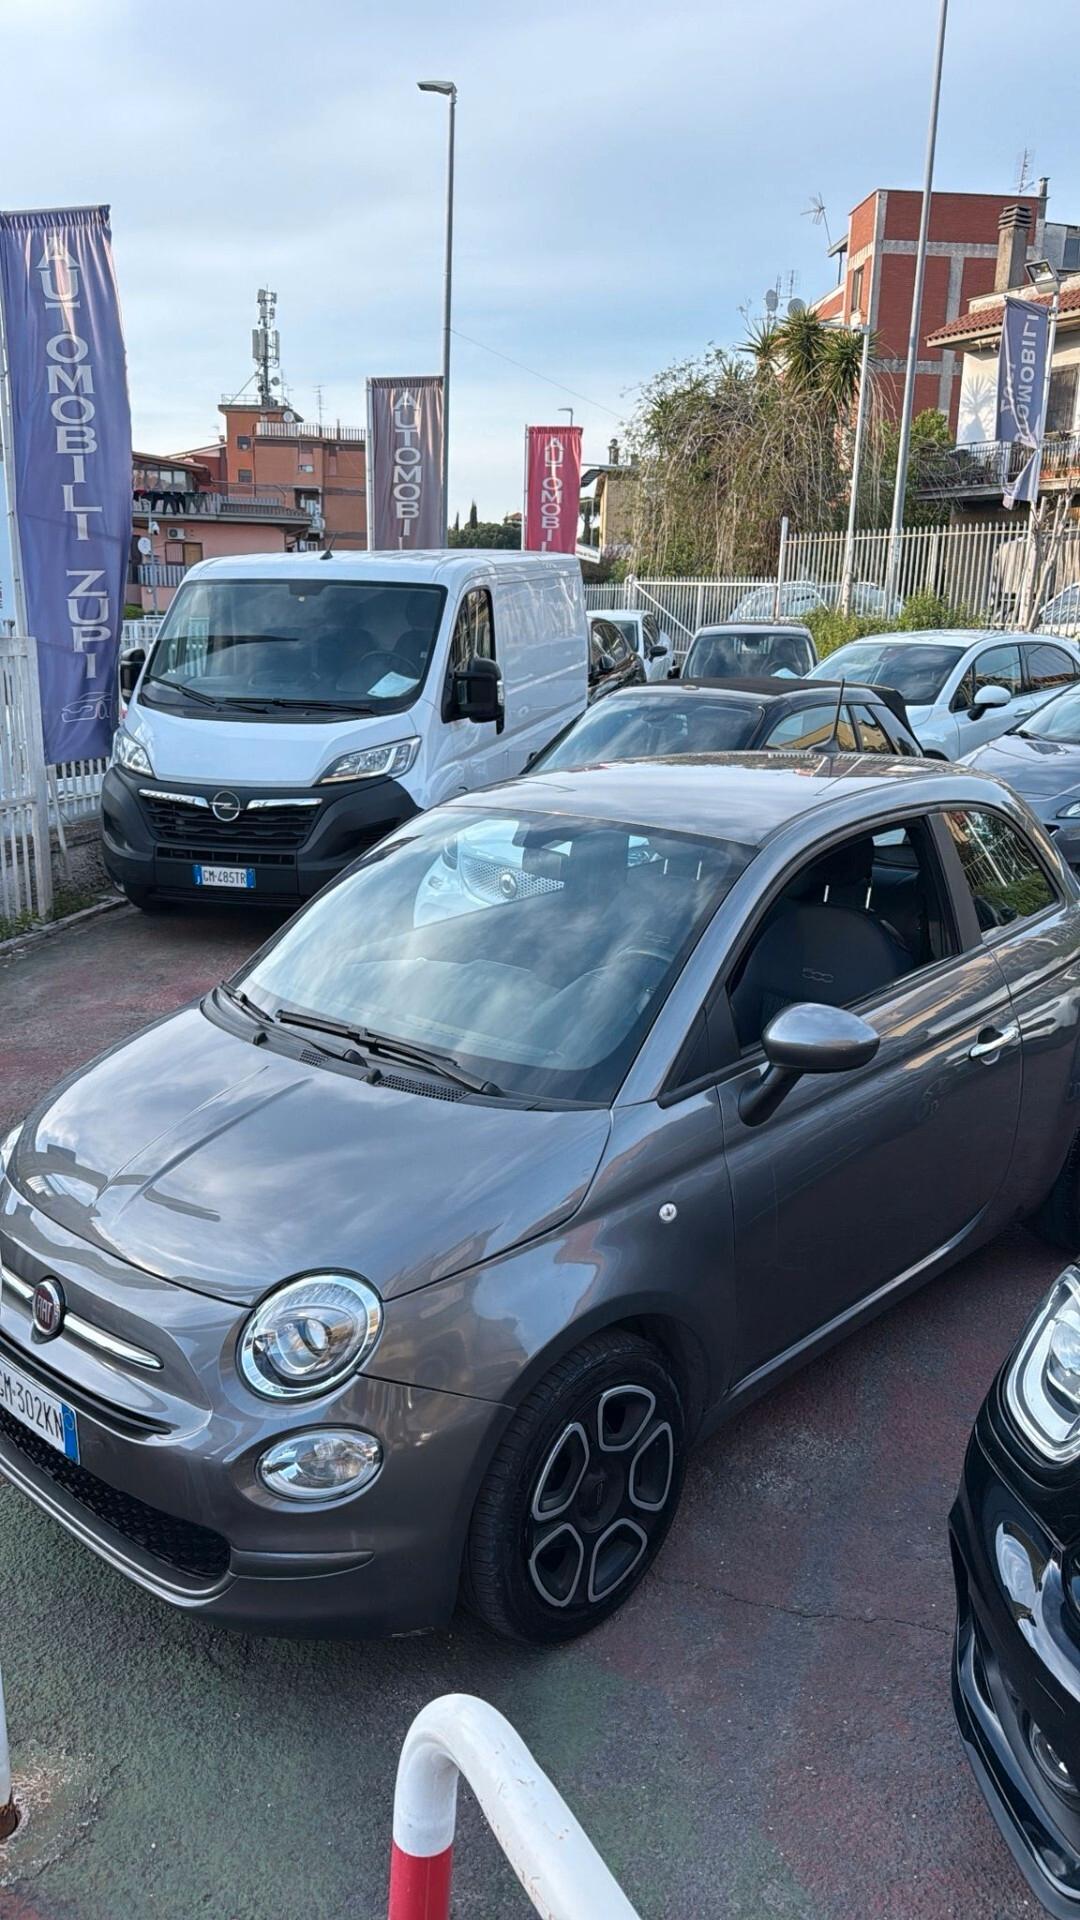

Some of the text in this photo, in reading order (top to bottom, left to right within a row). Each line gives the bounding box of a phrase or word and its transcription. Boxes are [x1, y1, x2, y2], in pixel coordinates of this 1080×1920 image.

[36, 237, 111, 679] AUTOMOBILI ZUPI
[36, 1294, 53, 1324] FIAT
